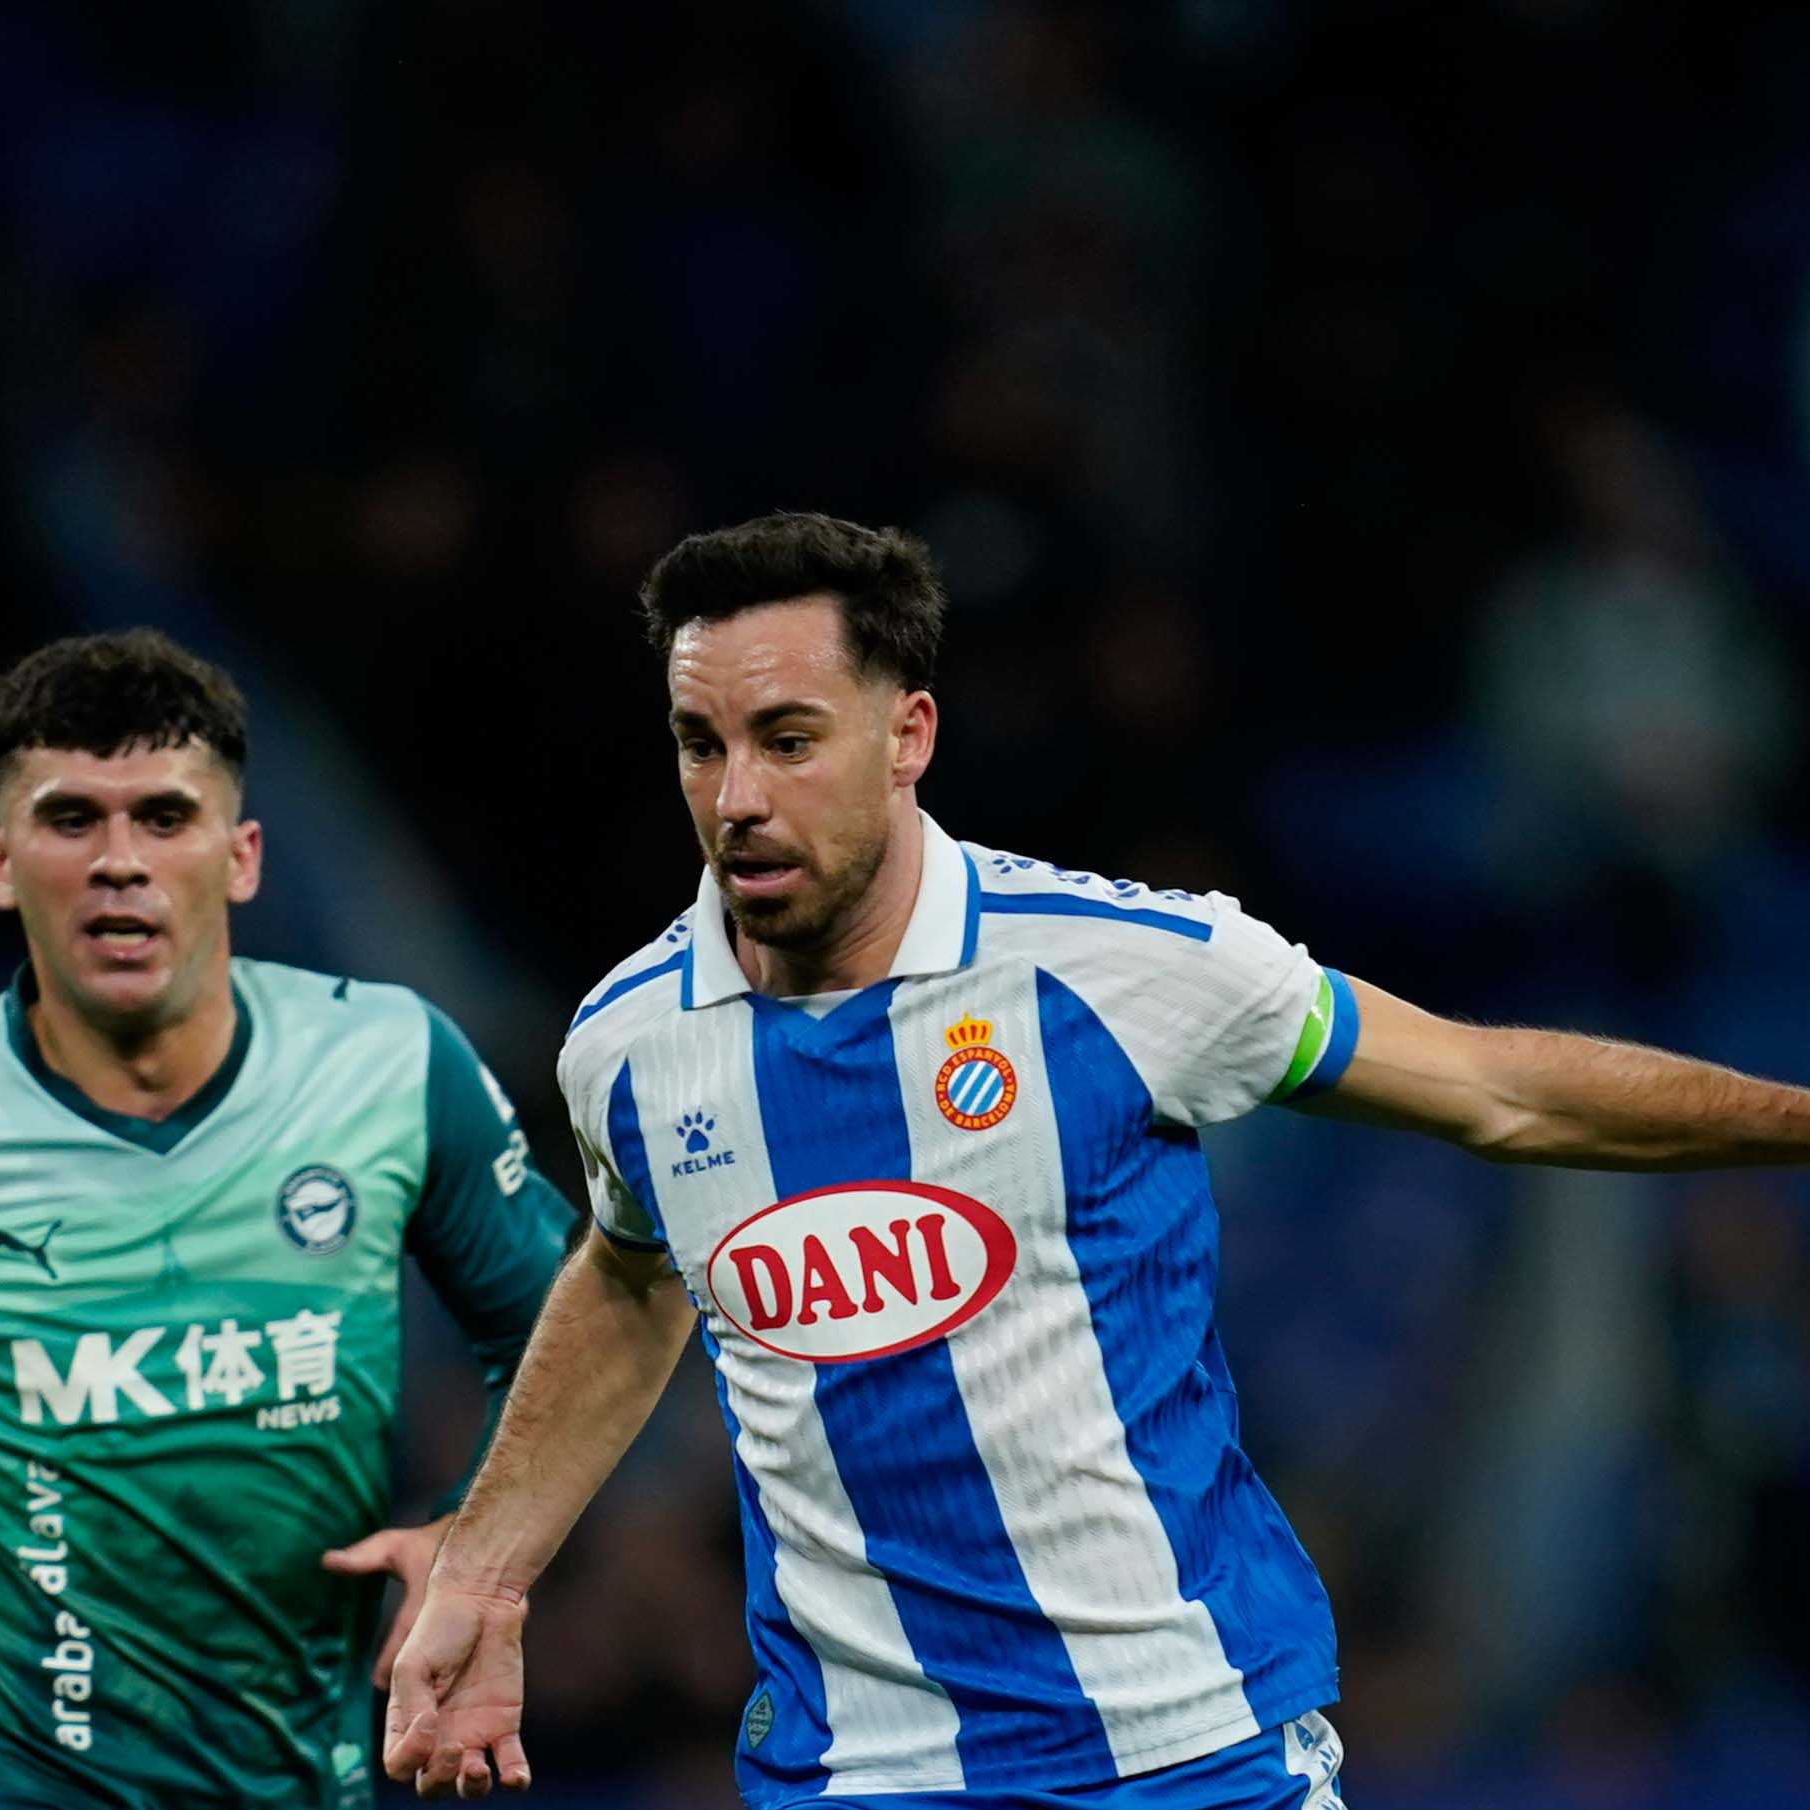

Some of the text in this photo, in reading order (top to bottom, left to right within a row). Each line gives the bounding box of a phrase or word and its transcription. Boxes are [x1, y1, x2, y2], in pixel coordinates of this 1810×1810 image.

[671, 1150, 736, 1178] KELME
[729, 1213, 961, 1331] DANI
[255, 1395, 342, 1431] NEWS
